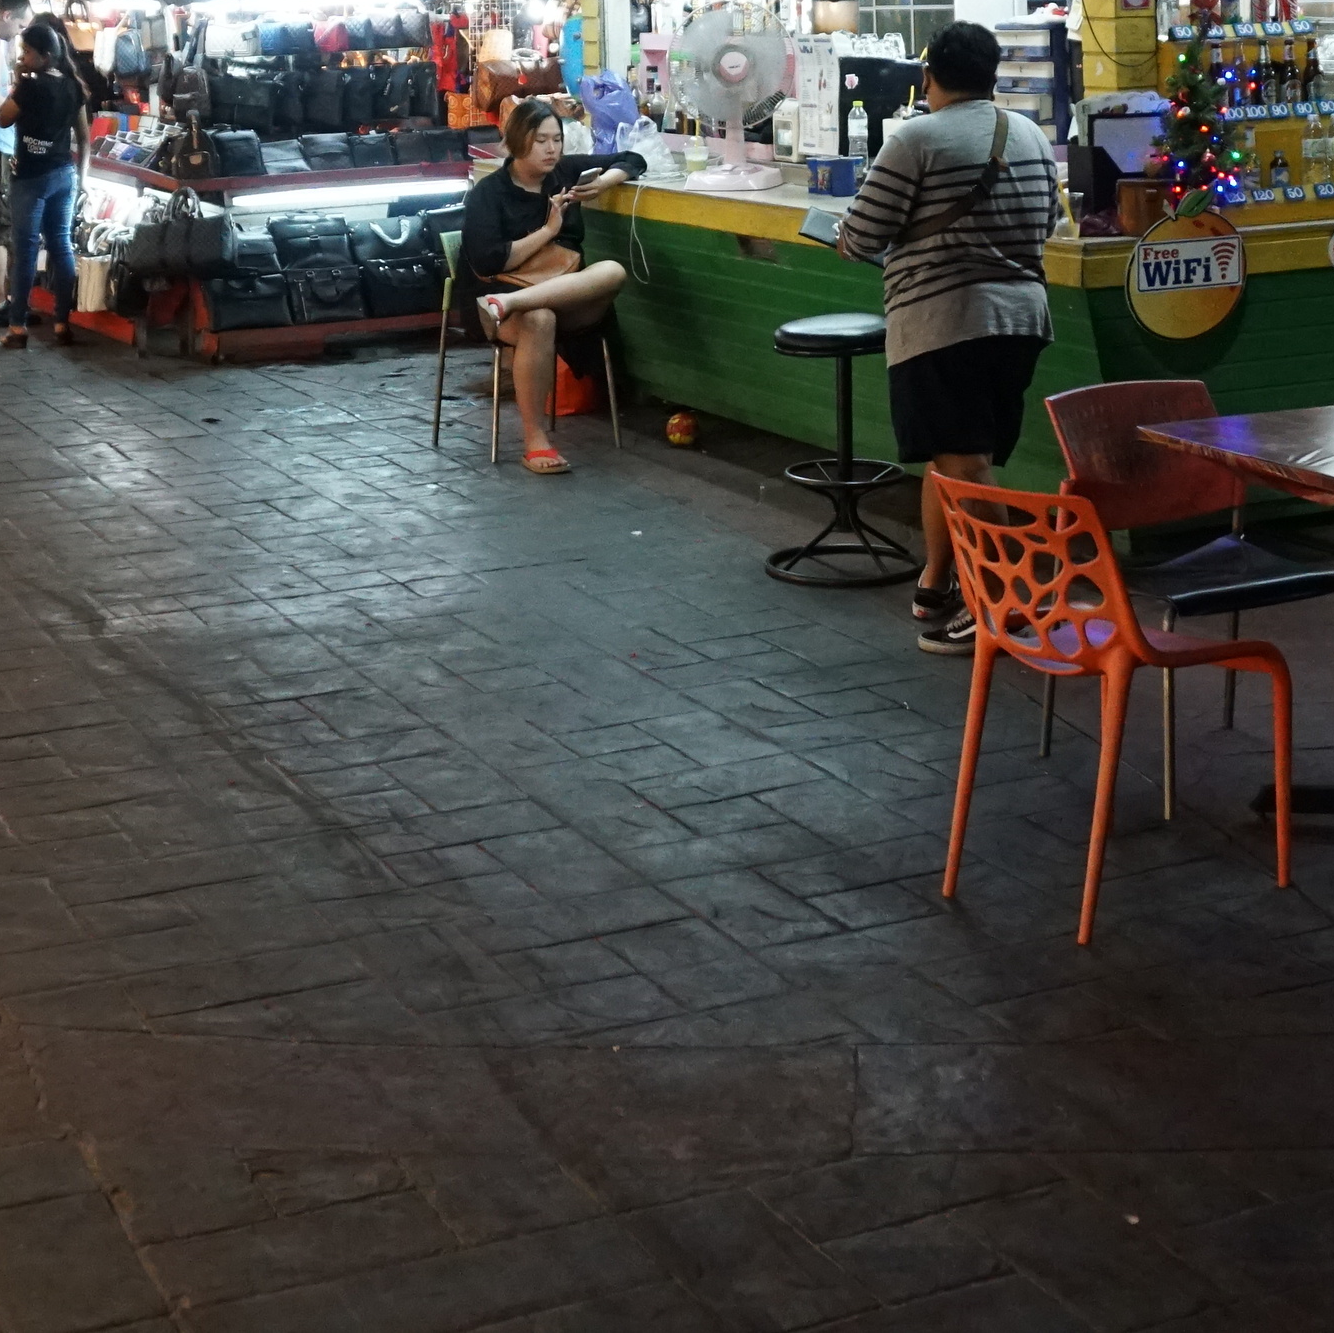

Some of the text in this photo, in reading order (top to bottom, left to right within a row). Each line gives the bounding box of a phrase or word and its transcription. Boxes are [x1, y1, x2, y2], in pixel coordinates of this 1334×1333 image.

[1175, 25, 1192, 39] 50
[1237, 22, 1254, 35] 50
[1266, 21, 1282, 35] 50
[1294, 19, 1310, 32] 50
[1246, 105, 1267, 118] 100
[1271, 104, 1288, 116] 90
[1296, 102, 1313, 115] 90
[1253, 189, 1275, 202] 120
[1286, 186, 1303, 199] 50
[1318, 183, 1334, 196] 20
[1142, 248, 1179, 261] Free
[1142, 257, 1212, 287] WiFi
